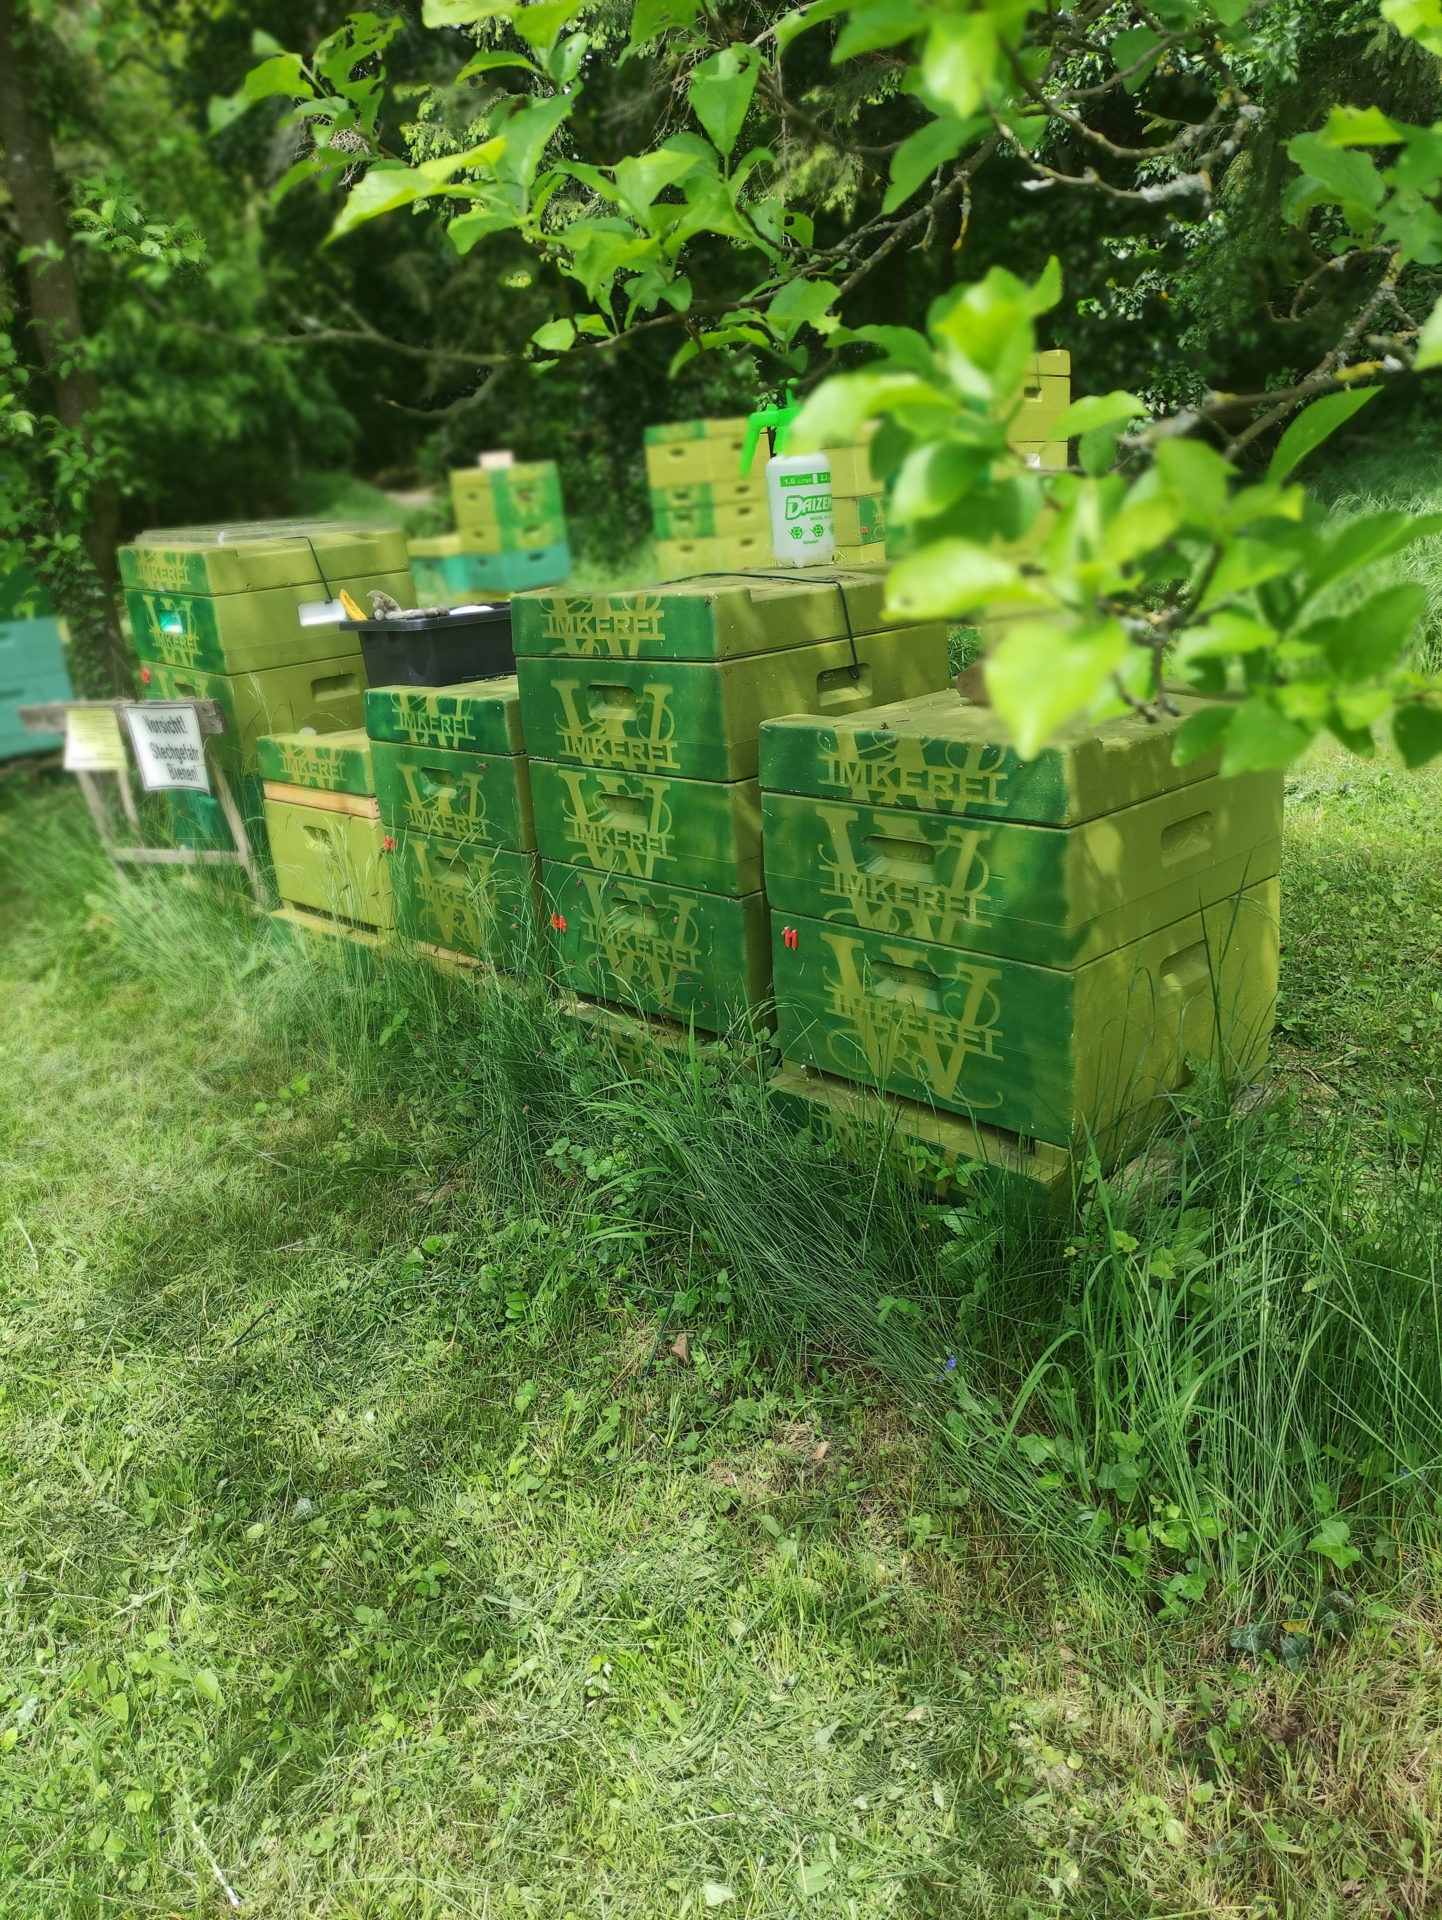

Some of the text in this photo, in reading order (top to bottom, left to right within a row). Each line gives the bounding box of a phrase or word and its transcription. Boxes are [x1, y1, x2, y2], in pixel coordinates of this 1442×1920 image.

[136, 561, 191, 585] IMKEREI
[540, 609, 666, 641] IMKEREI
[149, 628, 203, 656] IMKEREI
[142, 714, 189, 734] Vorsicht!
[392, 708, 477, 741] IMKEREI
[150, 742, 200, 765] Stechgefahr
[556, 730, 681, 770] IMKEREI
[166, 763, 200, 782] Bienen!
[278, 753, 347, 782] IMKEREI
[817, 753, 1008, 807] IMKEREI
[403, 804, 493, 840] IMKEREI
[563, 817, 678, 862] IMKEREI
[818, 864, 993, 928] IMKEREI
[579, 916, 703, 975] IMKEREI
[823, 984, 1004, 1062] IMKEREI
